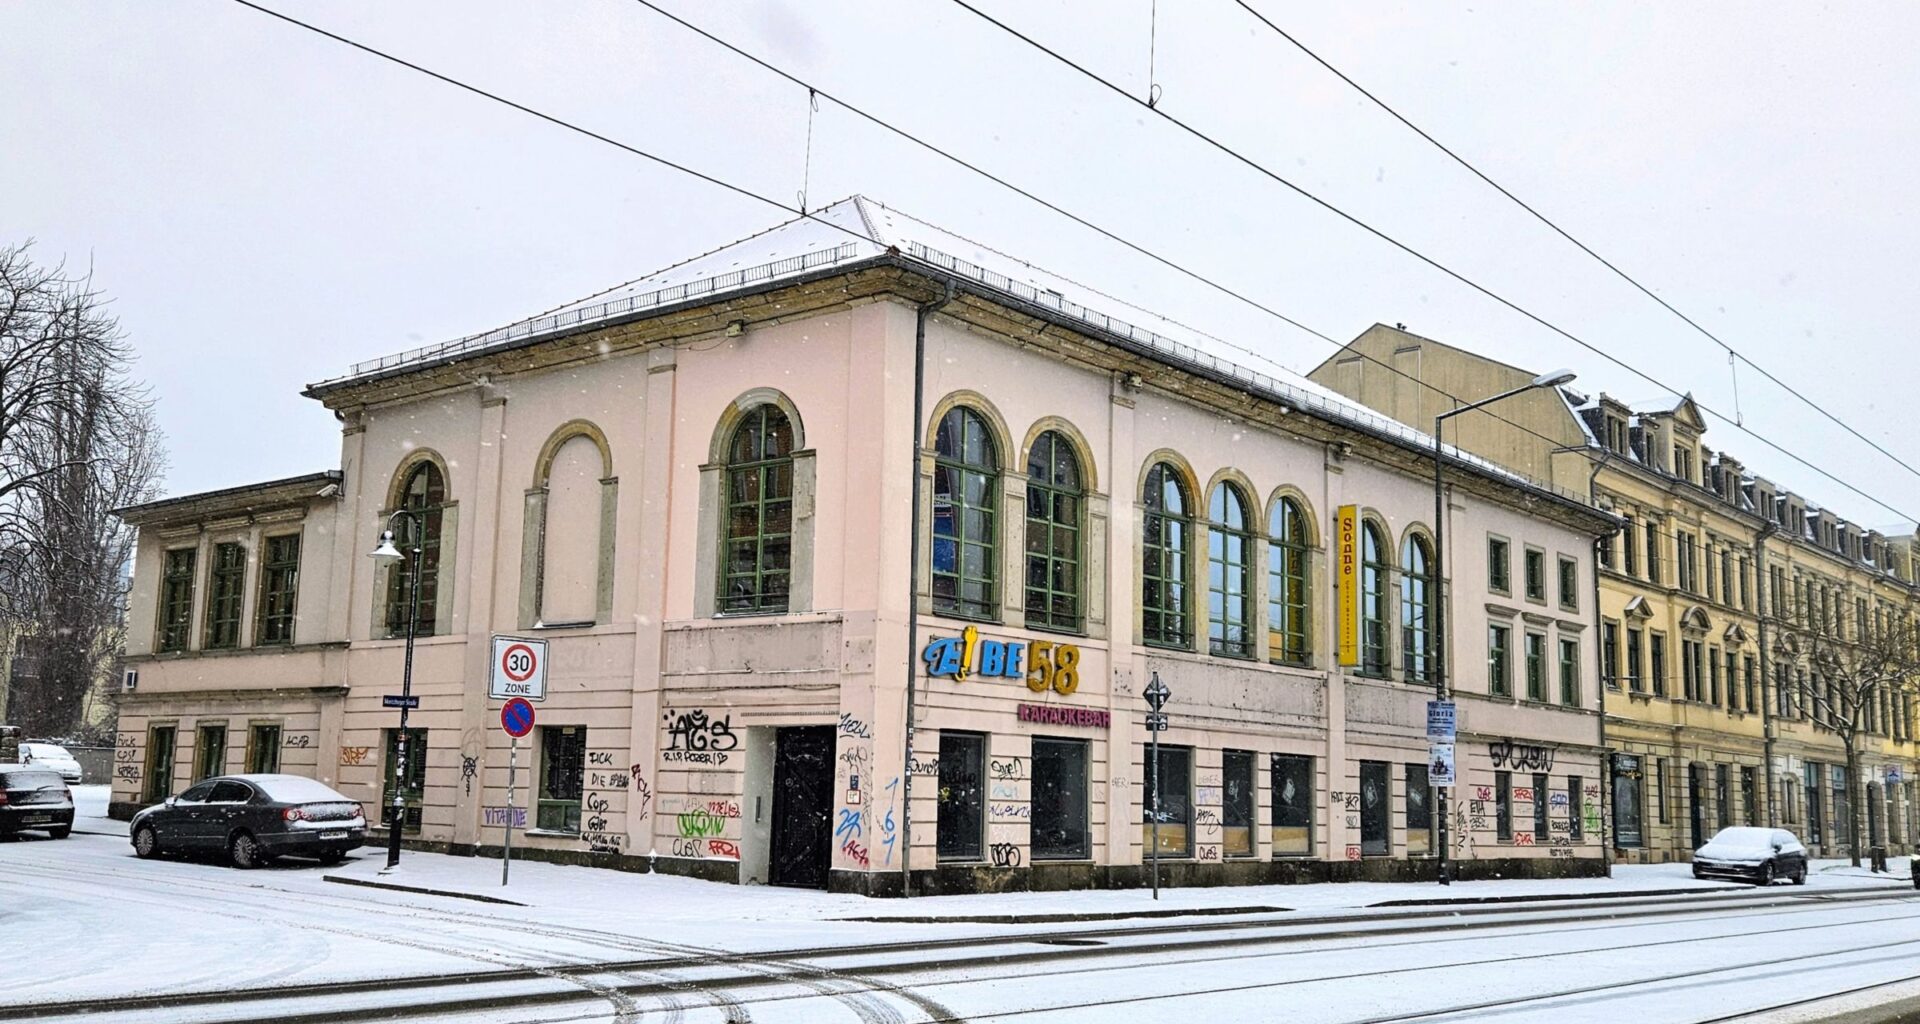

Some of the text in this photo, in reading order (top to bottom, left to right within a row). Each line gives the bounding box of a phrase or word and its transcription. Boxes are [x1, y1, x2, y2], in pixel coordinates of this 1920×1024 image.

[1343, 517, 1352, 575] Sonne
[510, 654, 529, 672] 30
[1027, 640, 1080, 696] 58
[505, 683, 531, 694] ZONE
[1017, 703, 1110, 729] KARAOKEBAR
[591, 773, 606, 787] DIE
